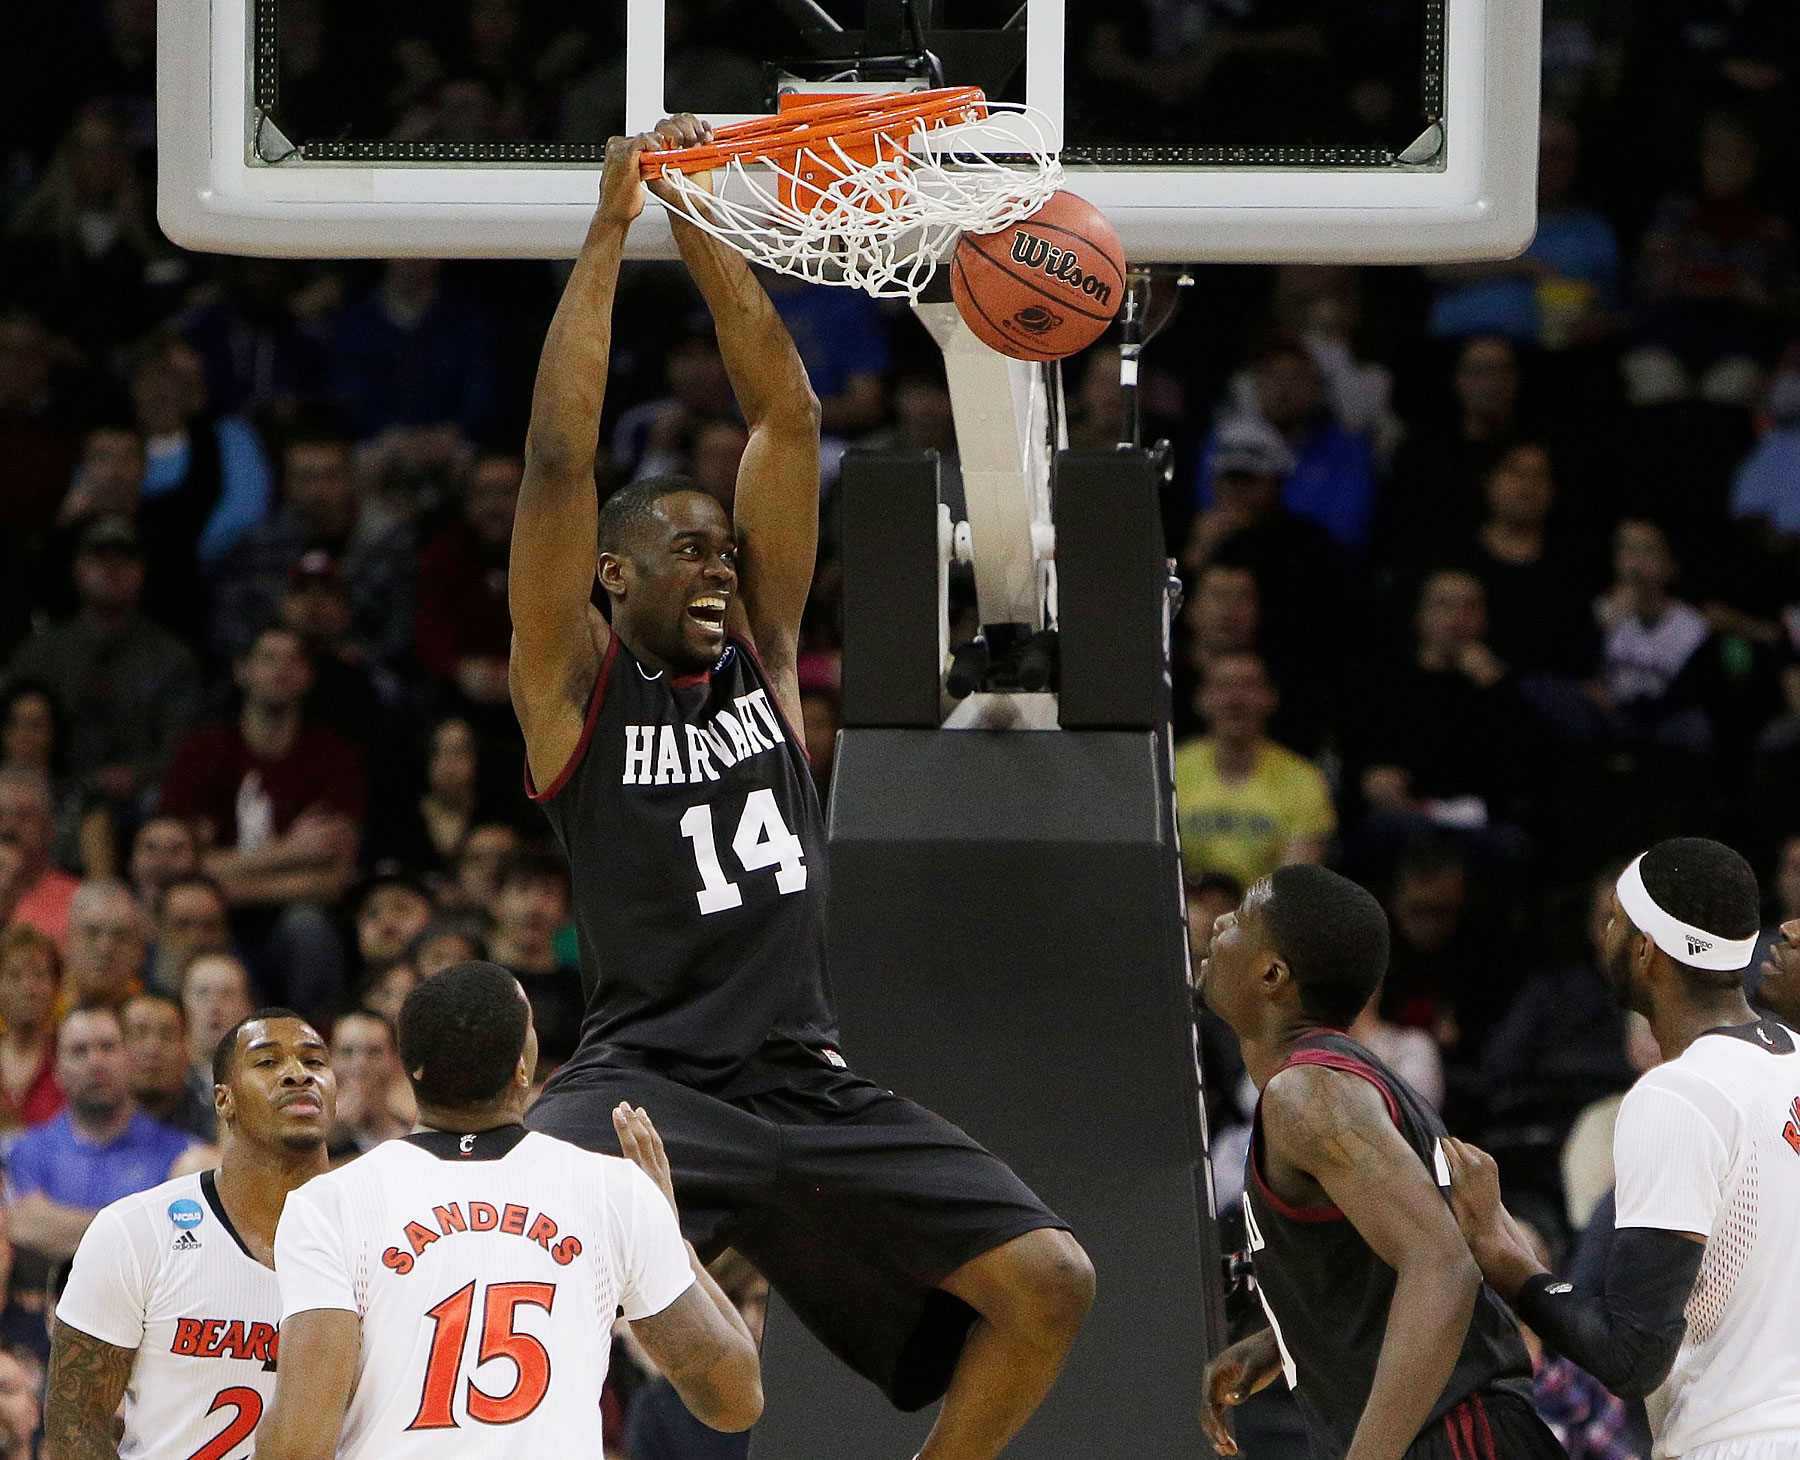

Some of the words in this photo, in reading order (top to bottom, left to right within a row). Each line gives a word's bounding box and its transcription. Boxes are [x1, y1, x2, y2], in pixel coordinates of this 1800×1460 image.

[1011, 230, 1112, 306] Wilson
[680, 788, 808, 915] 14
[172, 1211, 202, 1222] NCAA
[172, 1242, 202, 1251] adidas
[382, 1201, 583, 1275] SANDERS
[402, 1278, 557, 1432] 15
[186, 1386, 264, 1460] 2
